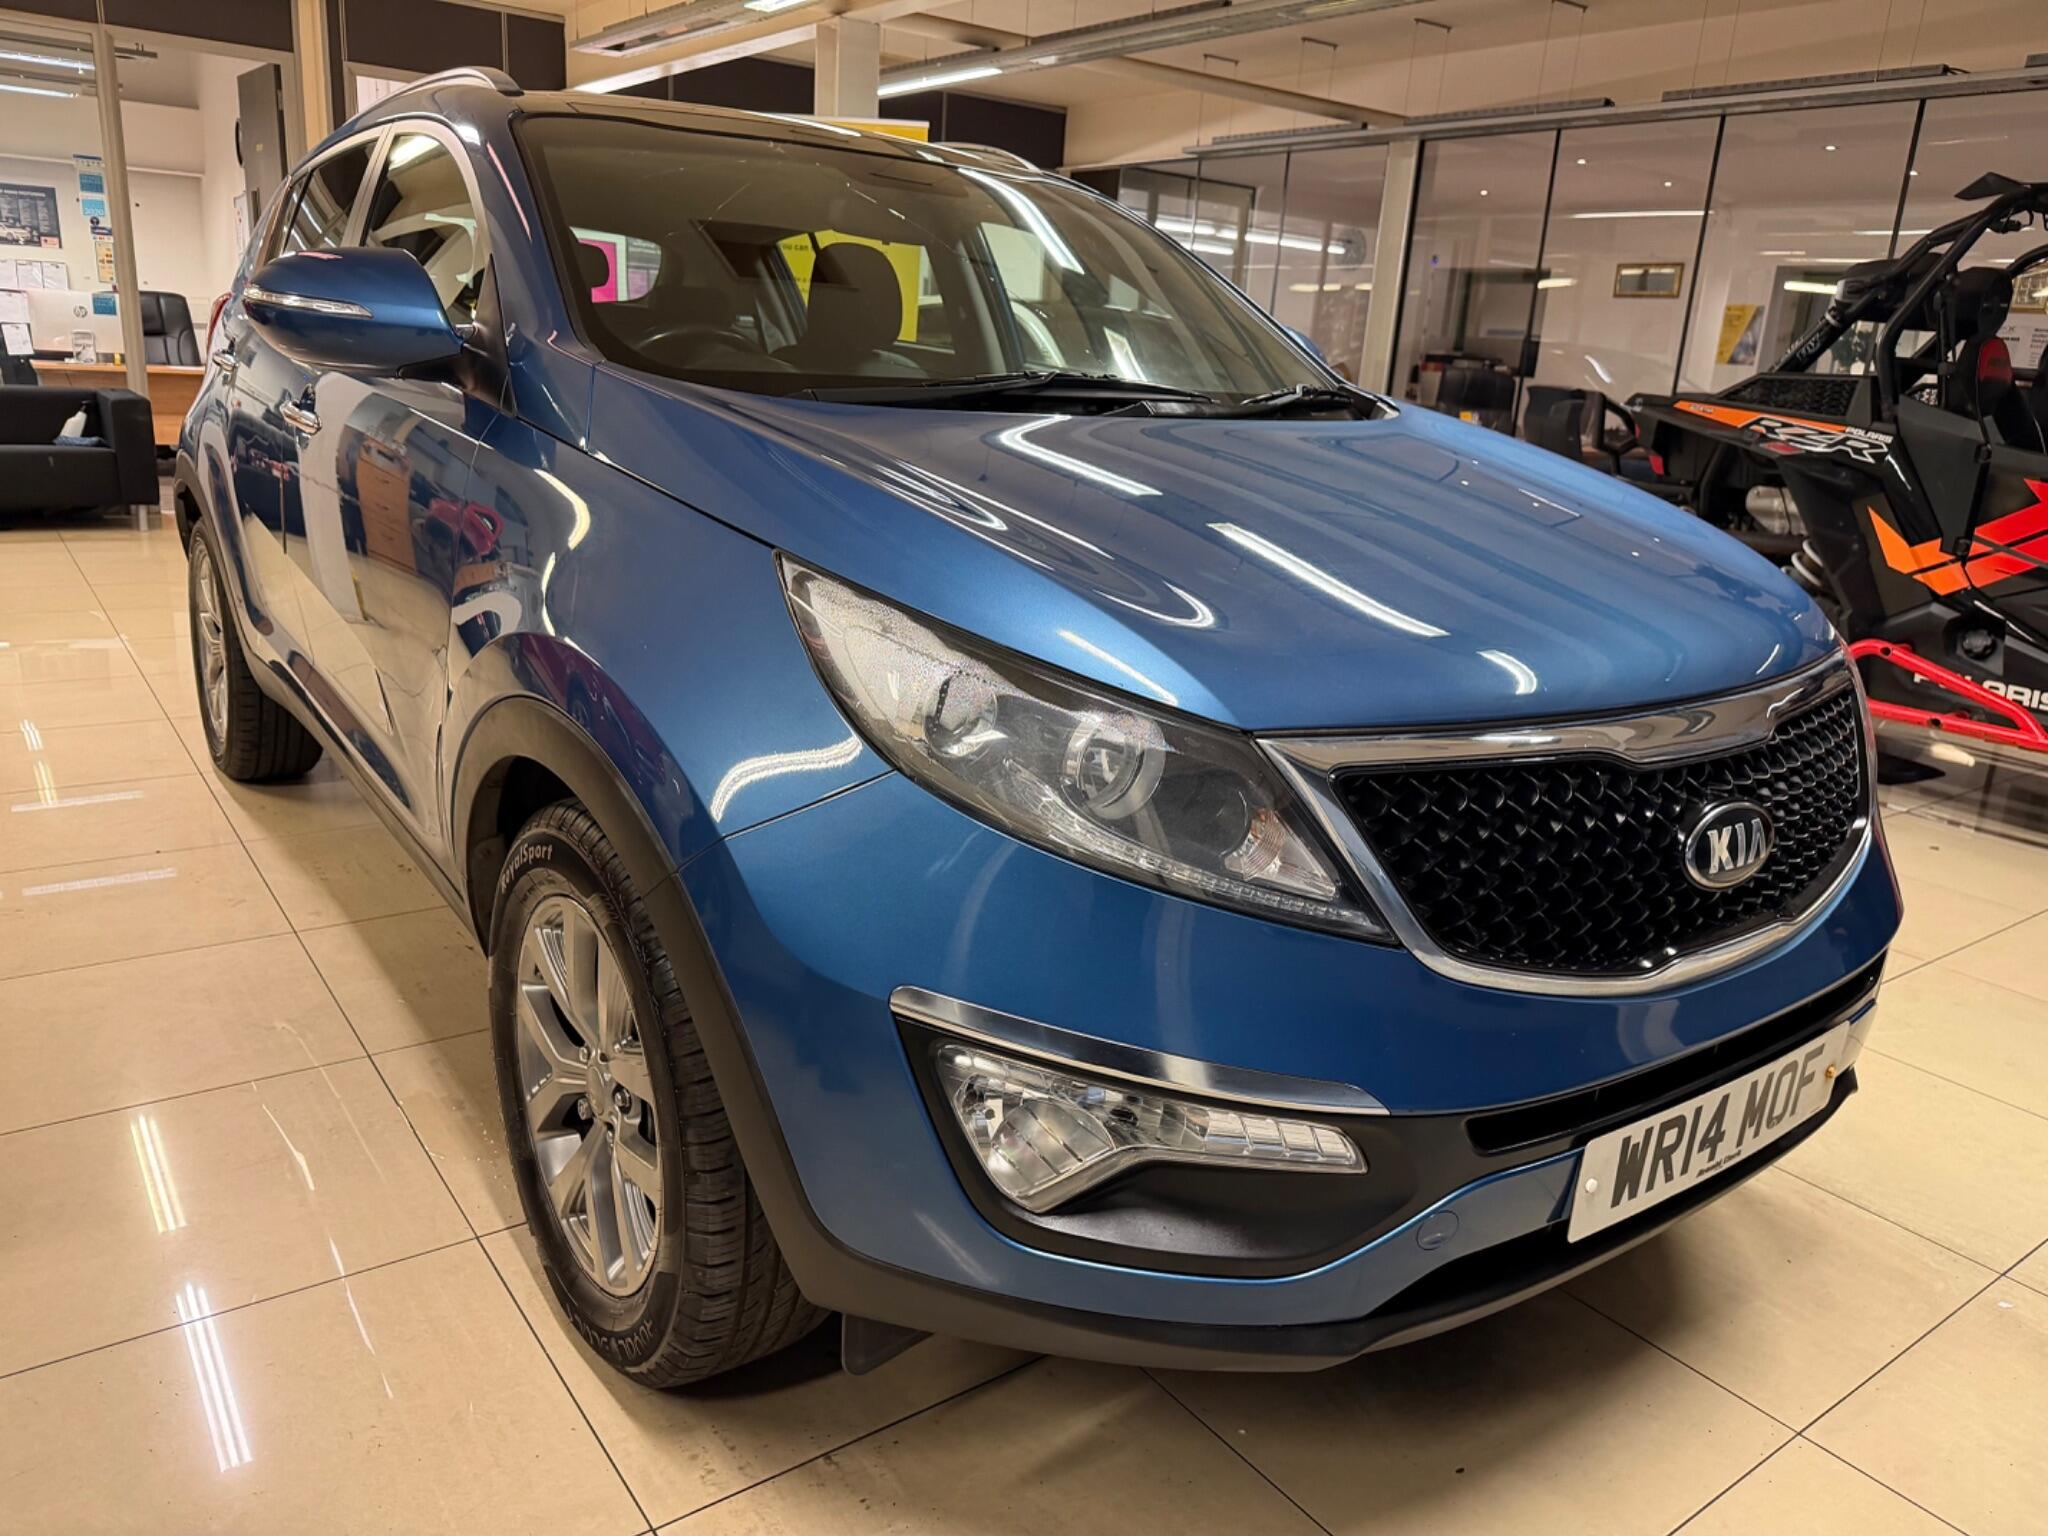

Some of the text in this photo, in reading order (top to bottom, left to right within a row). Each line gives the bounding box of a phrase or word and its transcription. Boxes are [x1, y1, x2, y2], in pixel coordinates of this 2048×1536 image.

[1747, 415, 1889, 464] RZR
[1845, 426, 1894, 443] POLARIS
[501, 843, 553, 895] RoyalSport
[1706, 817, 1767, 874] KIA
[1610, 1044, 1825, 1208] WR14 MOF
